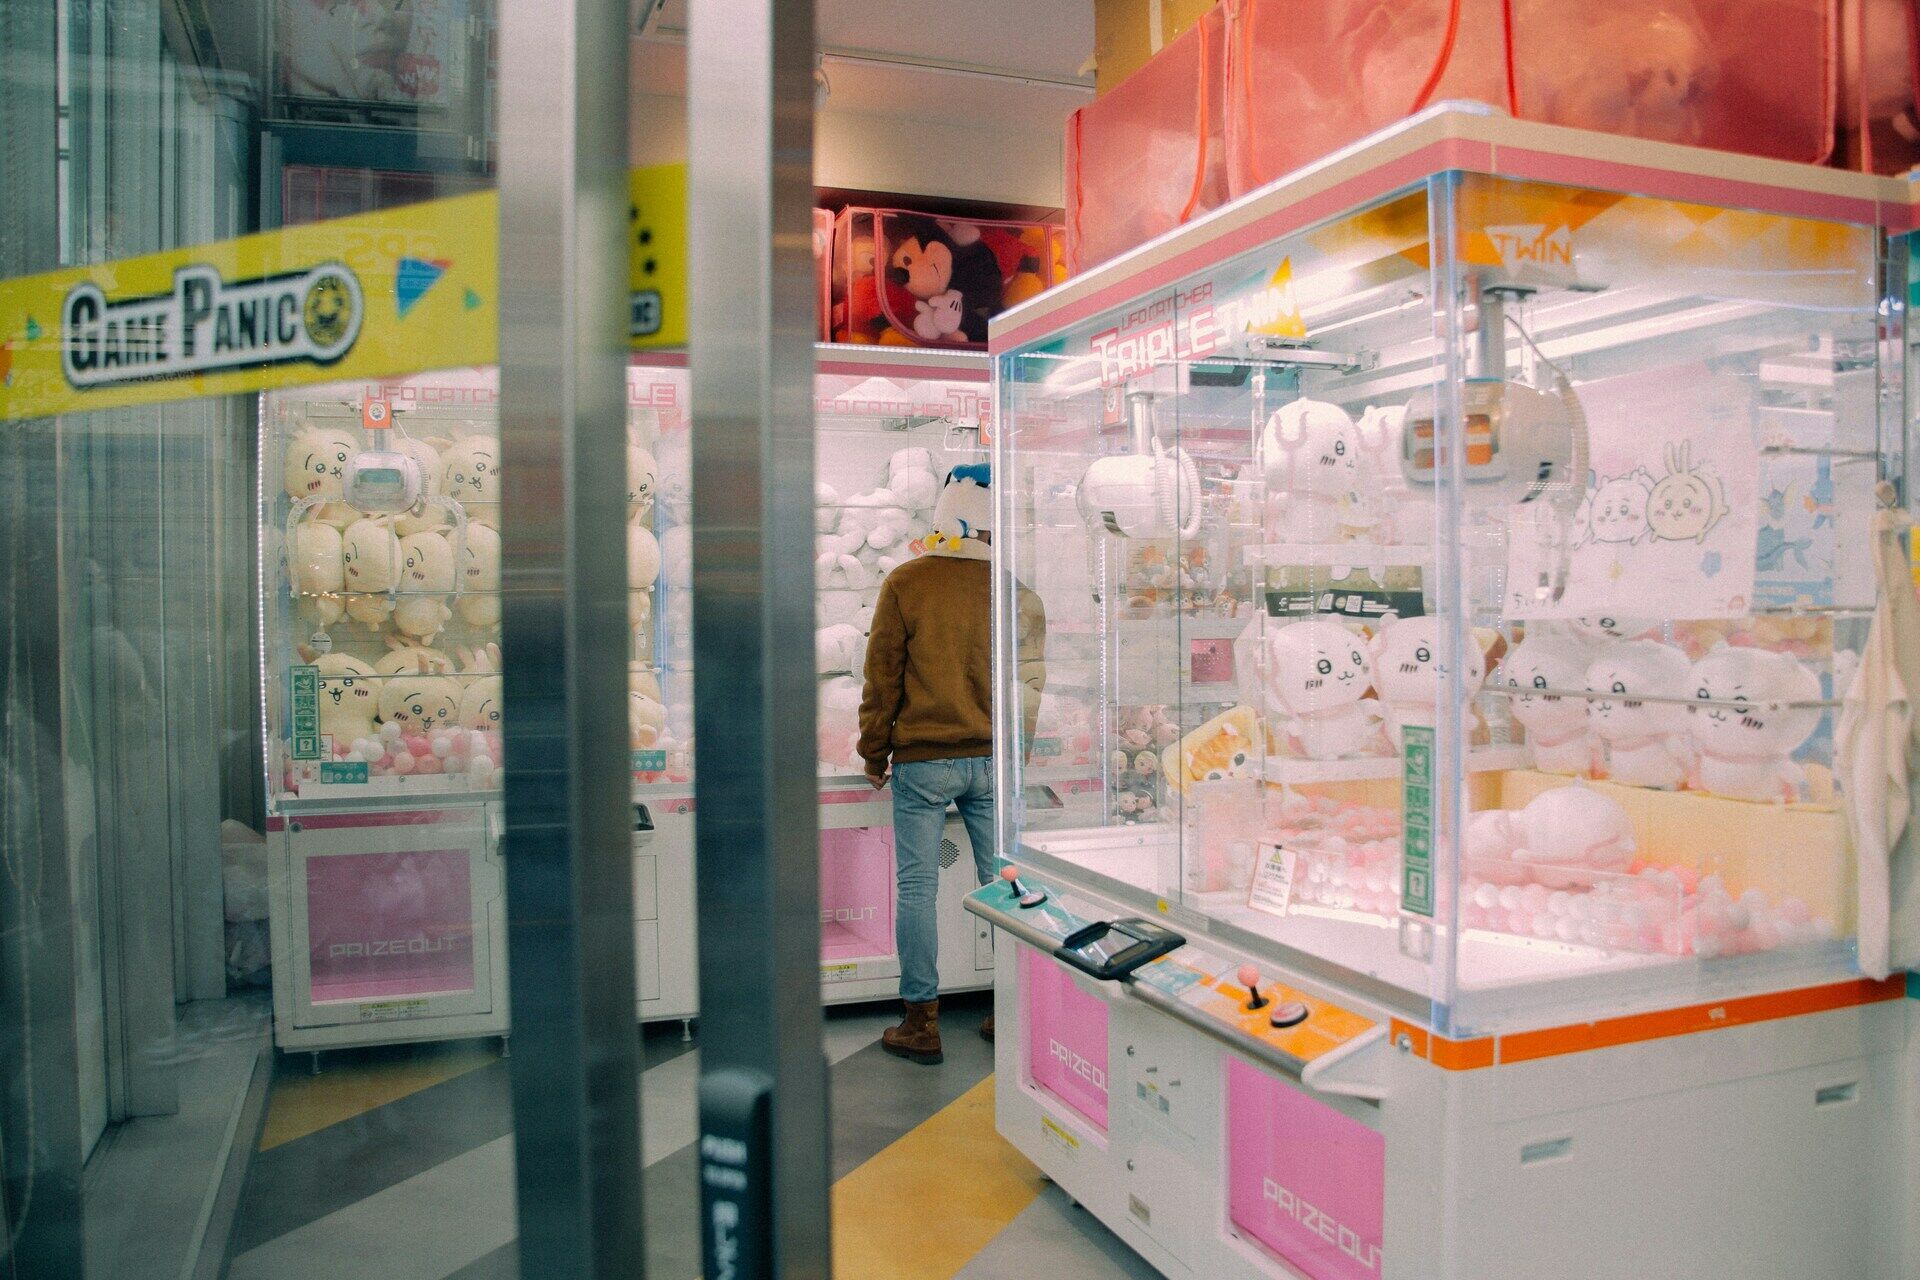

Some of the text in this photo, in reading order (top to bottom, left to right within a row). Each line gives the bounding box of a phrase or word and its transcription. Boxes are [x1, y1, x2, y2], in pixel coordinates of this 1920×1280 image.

[1494, 231, 1574, 267] TWIN
[70, 276, 299, 372] GAME PANIC
[1090, 303, 1216, 387] TRIPLE
[366, 384, 417, 402] UFO
